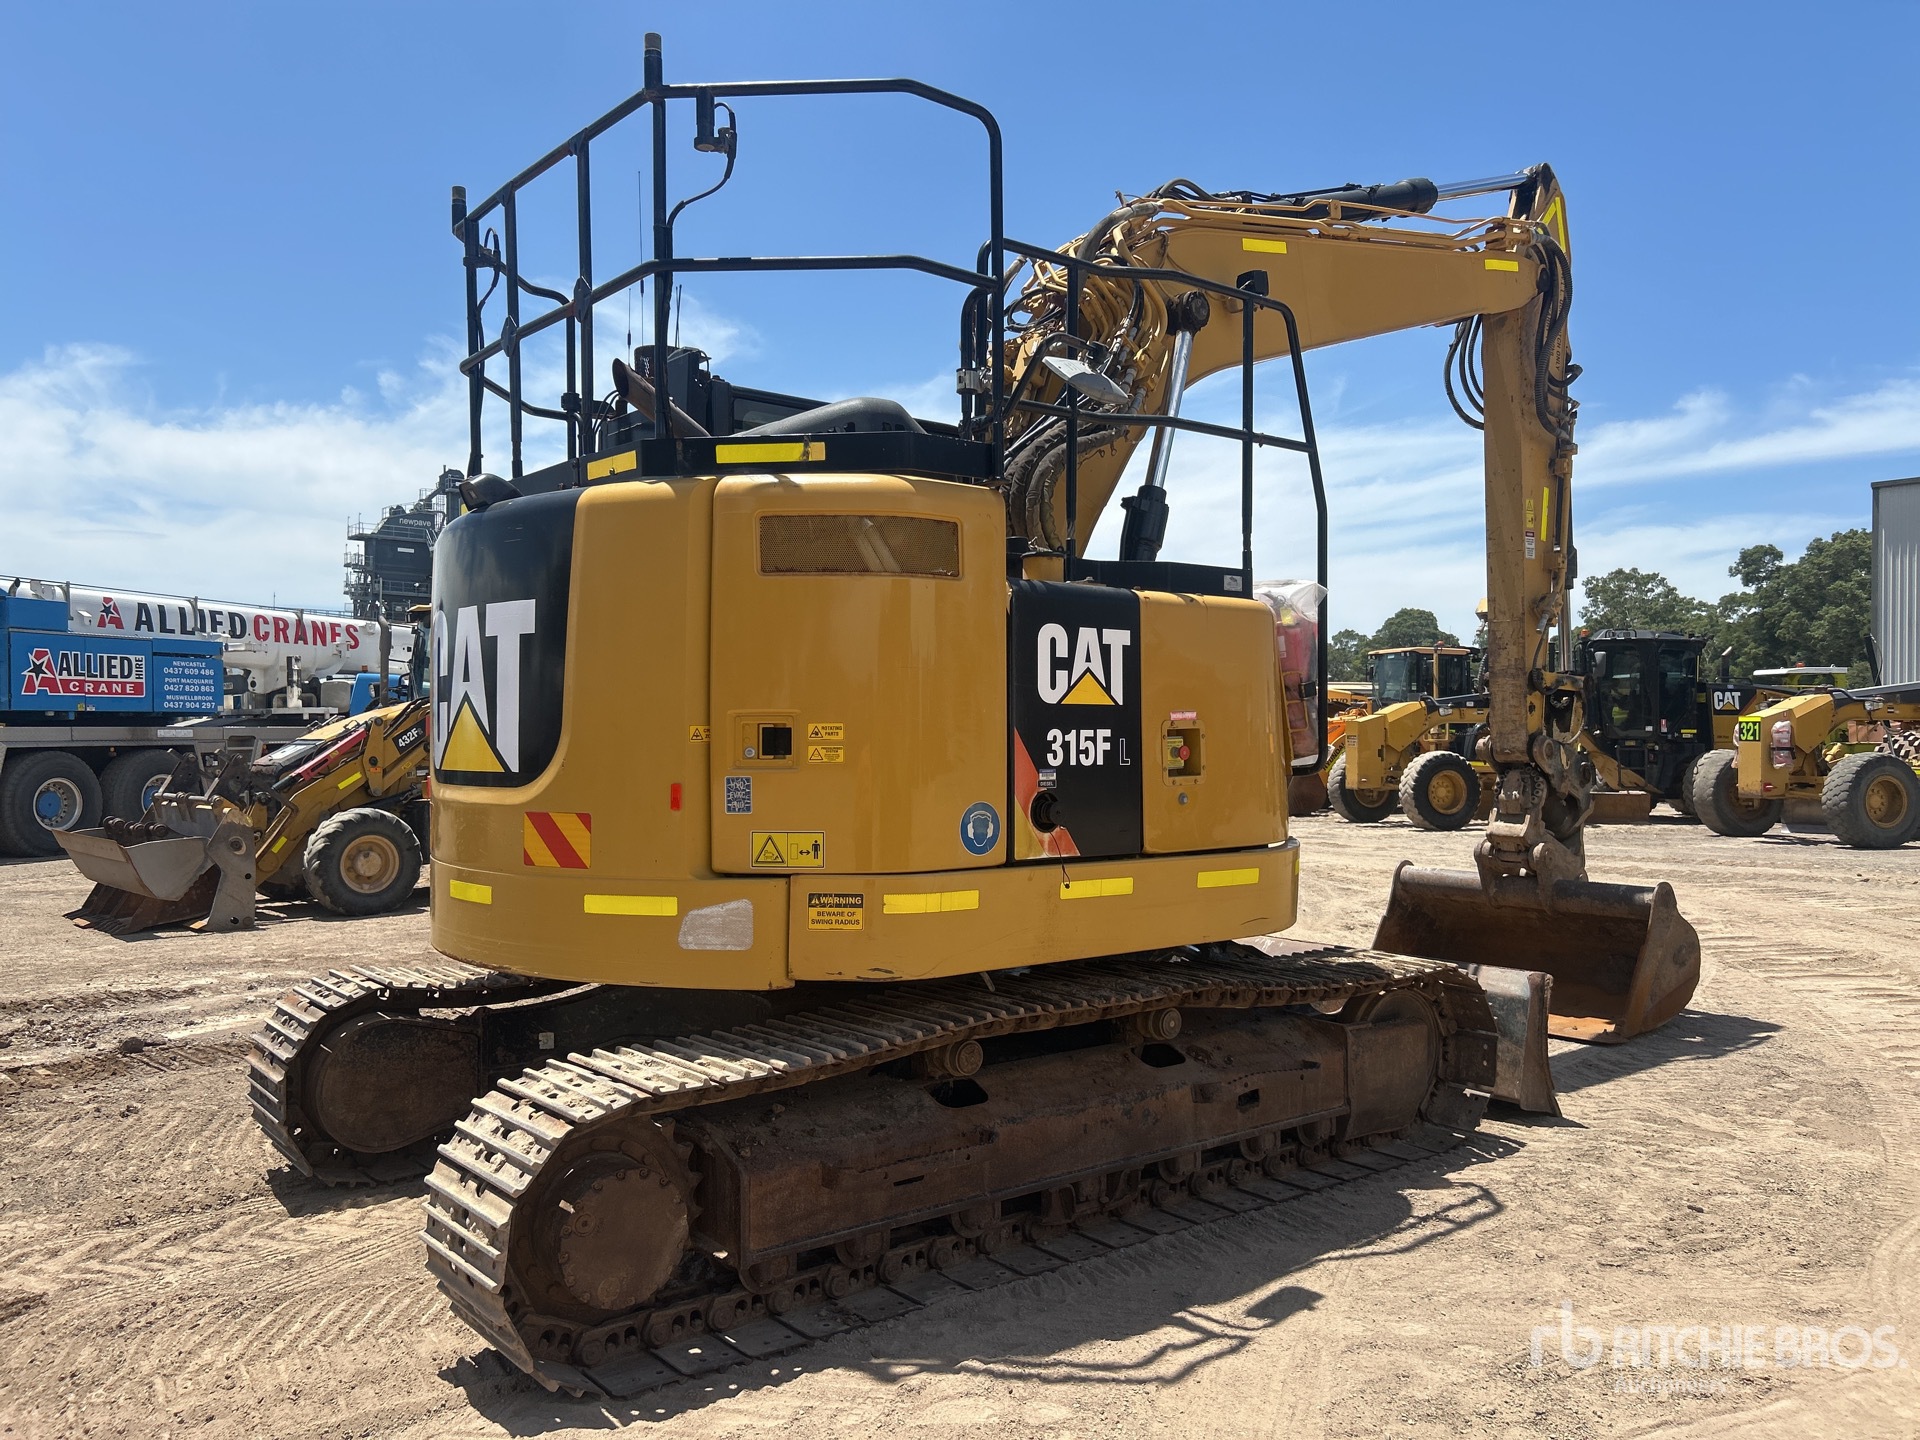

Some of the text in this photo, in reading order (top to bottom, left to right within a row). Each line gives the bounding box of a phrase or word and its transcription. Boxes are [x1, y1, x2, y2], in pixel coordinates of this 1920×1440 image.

[399, 518, 432, 527] newpave
[135, 603, 247, 640] ALLIED
[253, 614, 360, 650] CRANES
[58, 651, 133, 679] ALLIED
[135, 656, 144, 680] HIRE
[164, 667, 183, 675] 0437
[200, 668, 215, 676] 486
[1037, 623, 1131, 706] CAT
[69, 681, 135, 694] CRANE
[200, 685, 215, 693] 863
[434, 599, 536, 773] CAT
[164, 701, 184, 709] 0437
[185, 701, 200, 709] 904
[1713, 691, 1741, 710] CAT
[1740, 722, 1760, 740] 321
[1046, 728, 1131, 767] 315F L
[820, 896, 862, 905] WARNING
